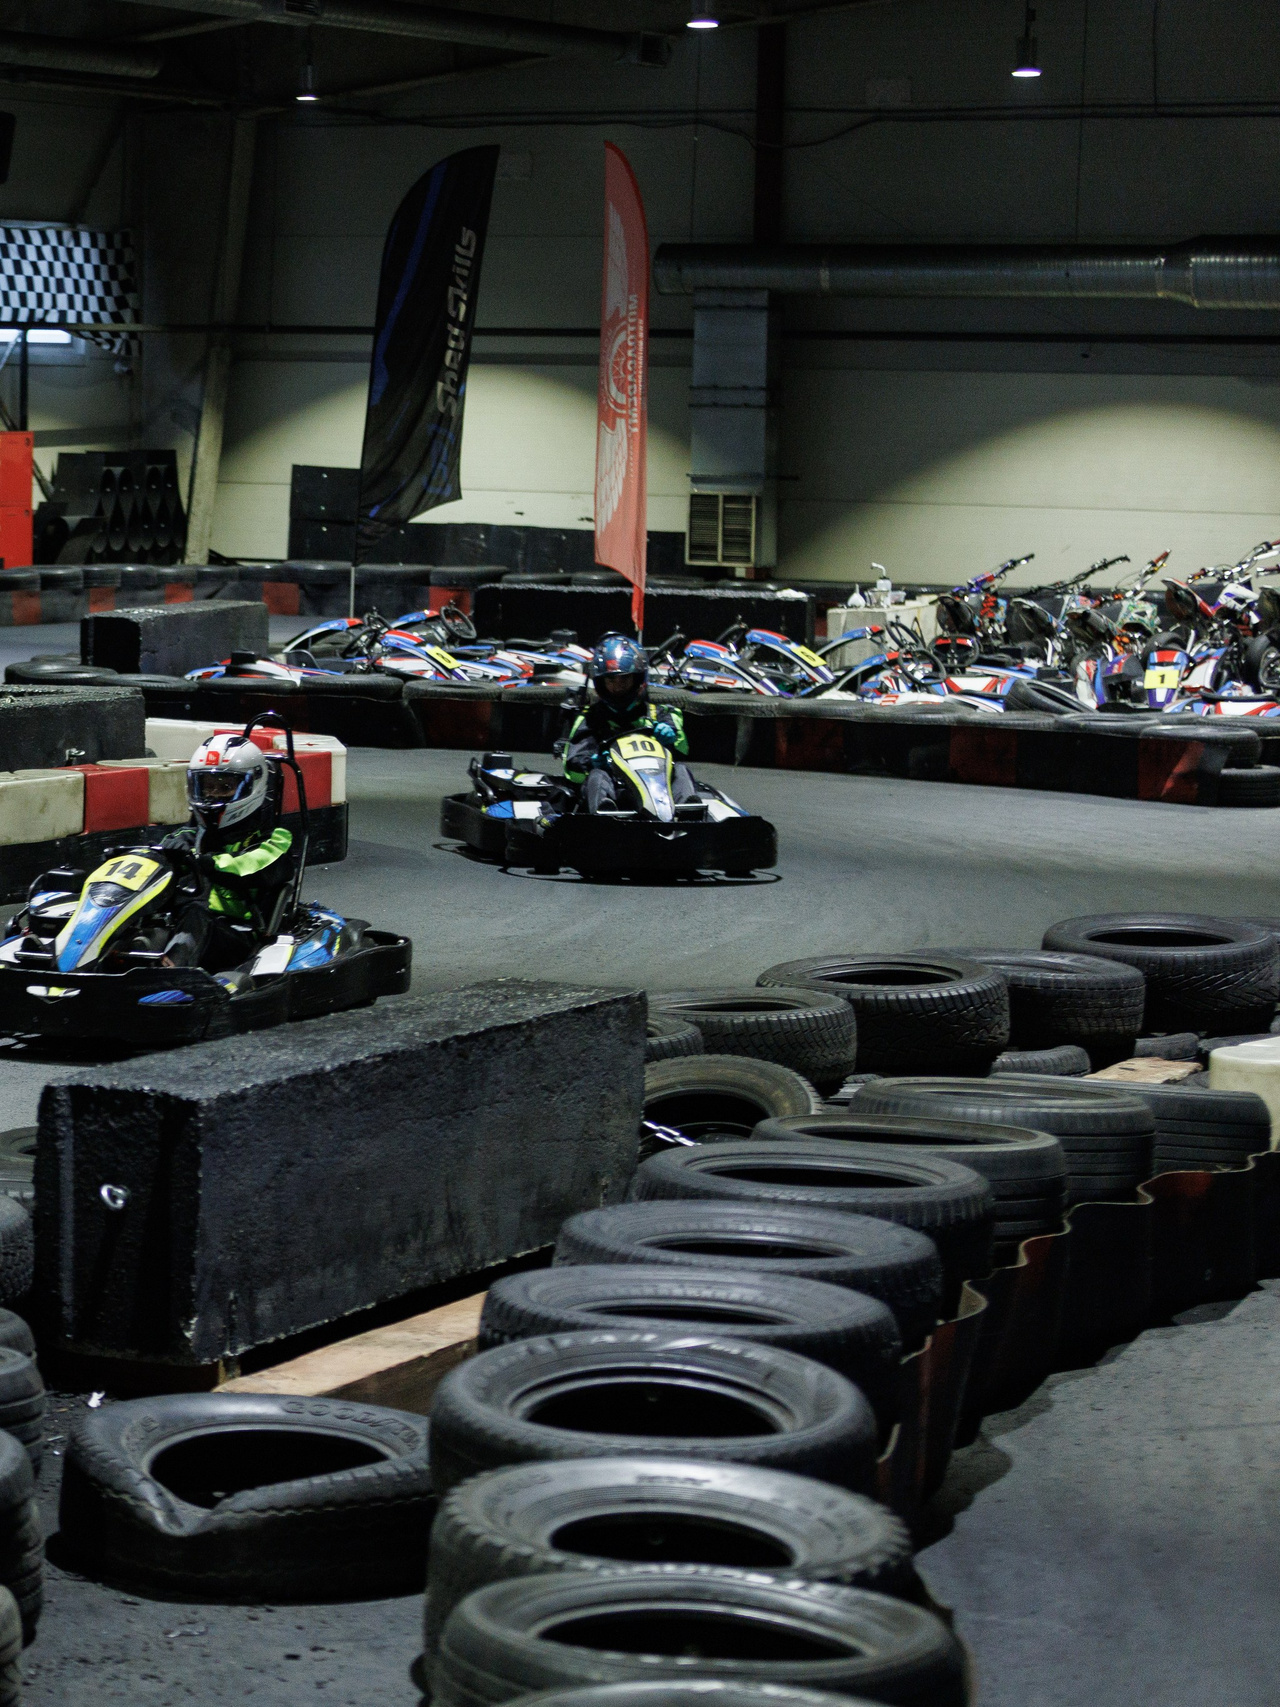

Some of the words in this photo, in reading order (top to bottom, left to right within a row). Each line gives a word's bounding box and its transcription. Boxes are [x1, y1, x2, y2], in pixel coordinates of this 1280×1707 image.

[447, 226, 477, 322] Skills
[1158, 674, 1166, 684] 1
[626, 740, 656, 752] 10
[105, 860, 144, 880] 14
